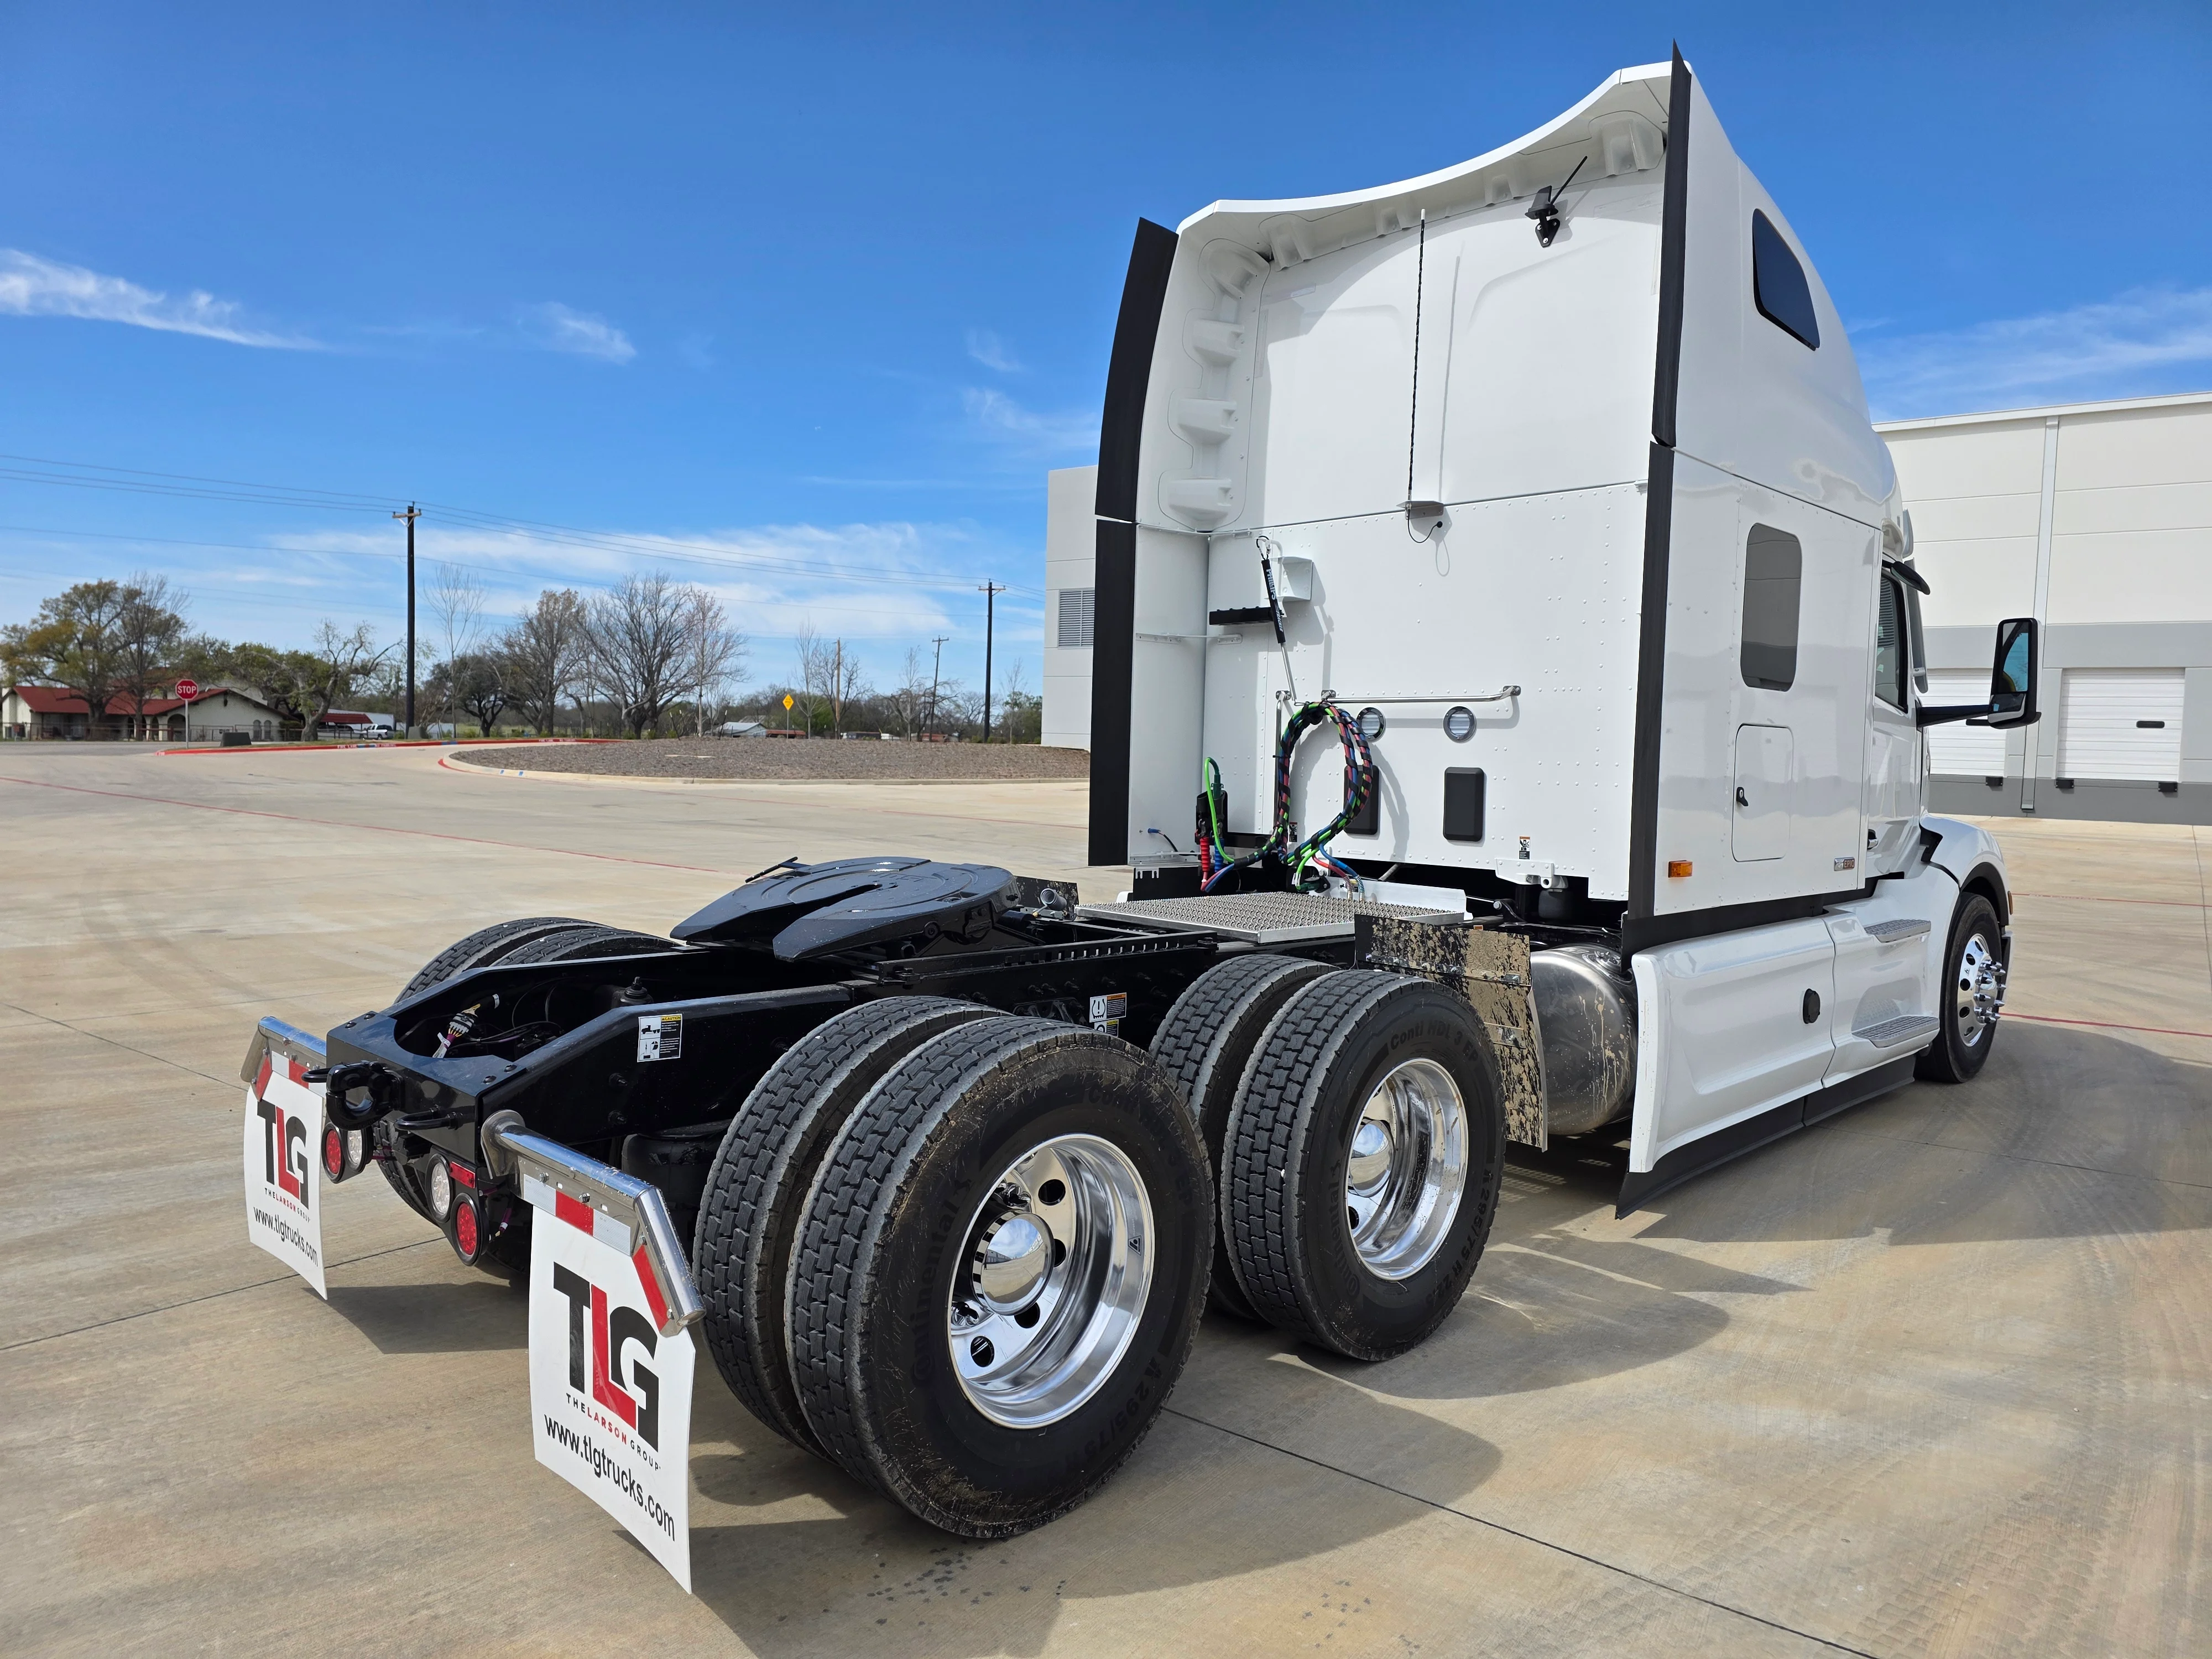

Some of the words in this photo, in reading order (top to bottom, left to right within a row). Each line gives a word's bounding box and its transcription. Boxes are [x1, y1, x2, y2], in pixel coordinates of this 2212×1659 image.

[178, 685, 197, 694] STOP
[1844, 859, 1854, 868] EPIQ
[1390, 1021, 1423, 1050] Conti
[1427, 1020, 1451, 1040] HDL
[1454, 1031, 1463, 1045] 3
[1462, 1040, 1479, 1061] EP
[257, 1099, 309, 1210] TLG
[253, 1206, 319, 1267] www.tlgtrucks.com
[297, 1207, 310, 1224] GROUP
[1328, 1181, 1360, 1298] Continental
[910, 1199, 961, 1387] Continental
[554, 1261, 659, 1452] TLG
[544, 1413, 675, 1542] www.tlgtrucks.com
[630, 1439, 659, 1472] GROUP
